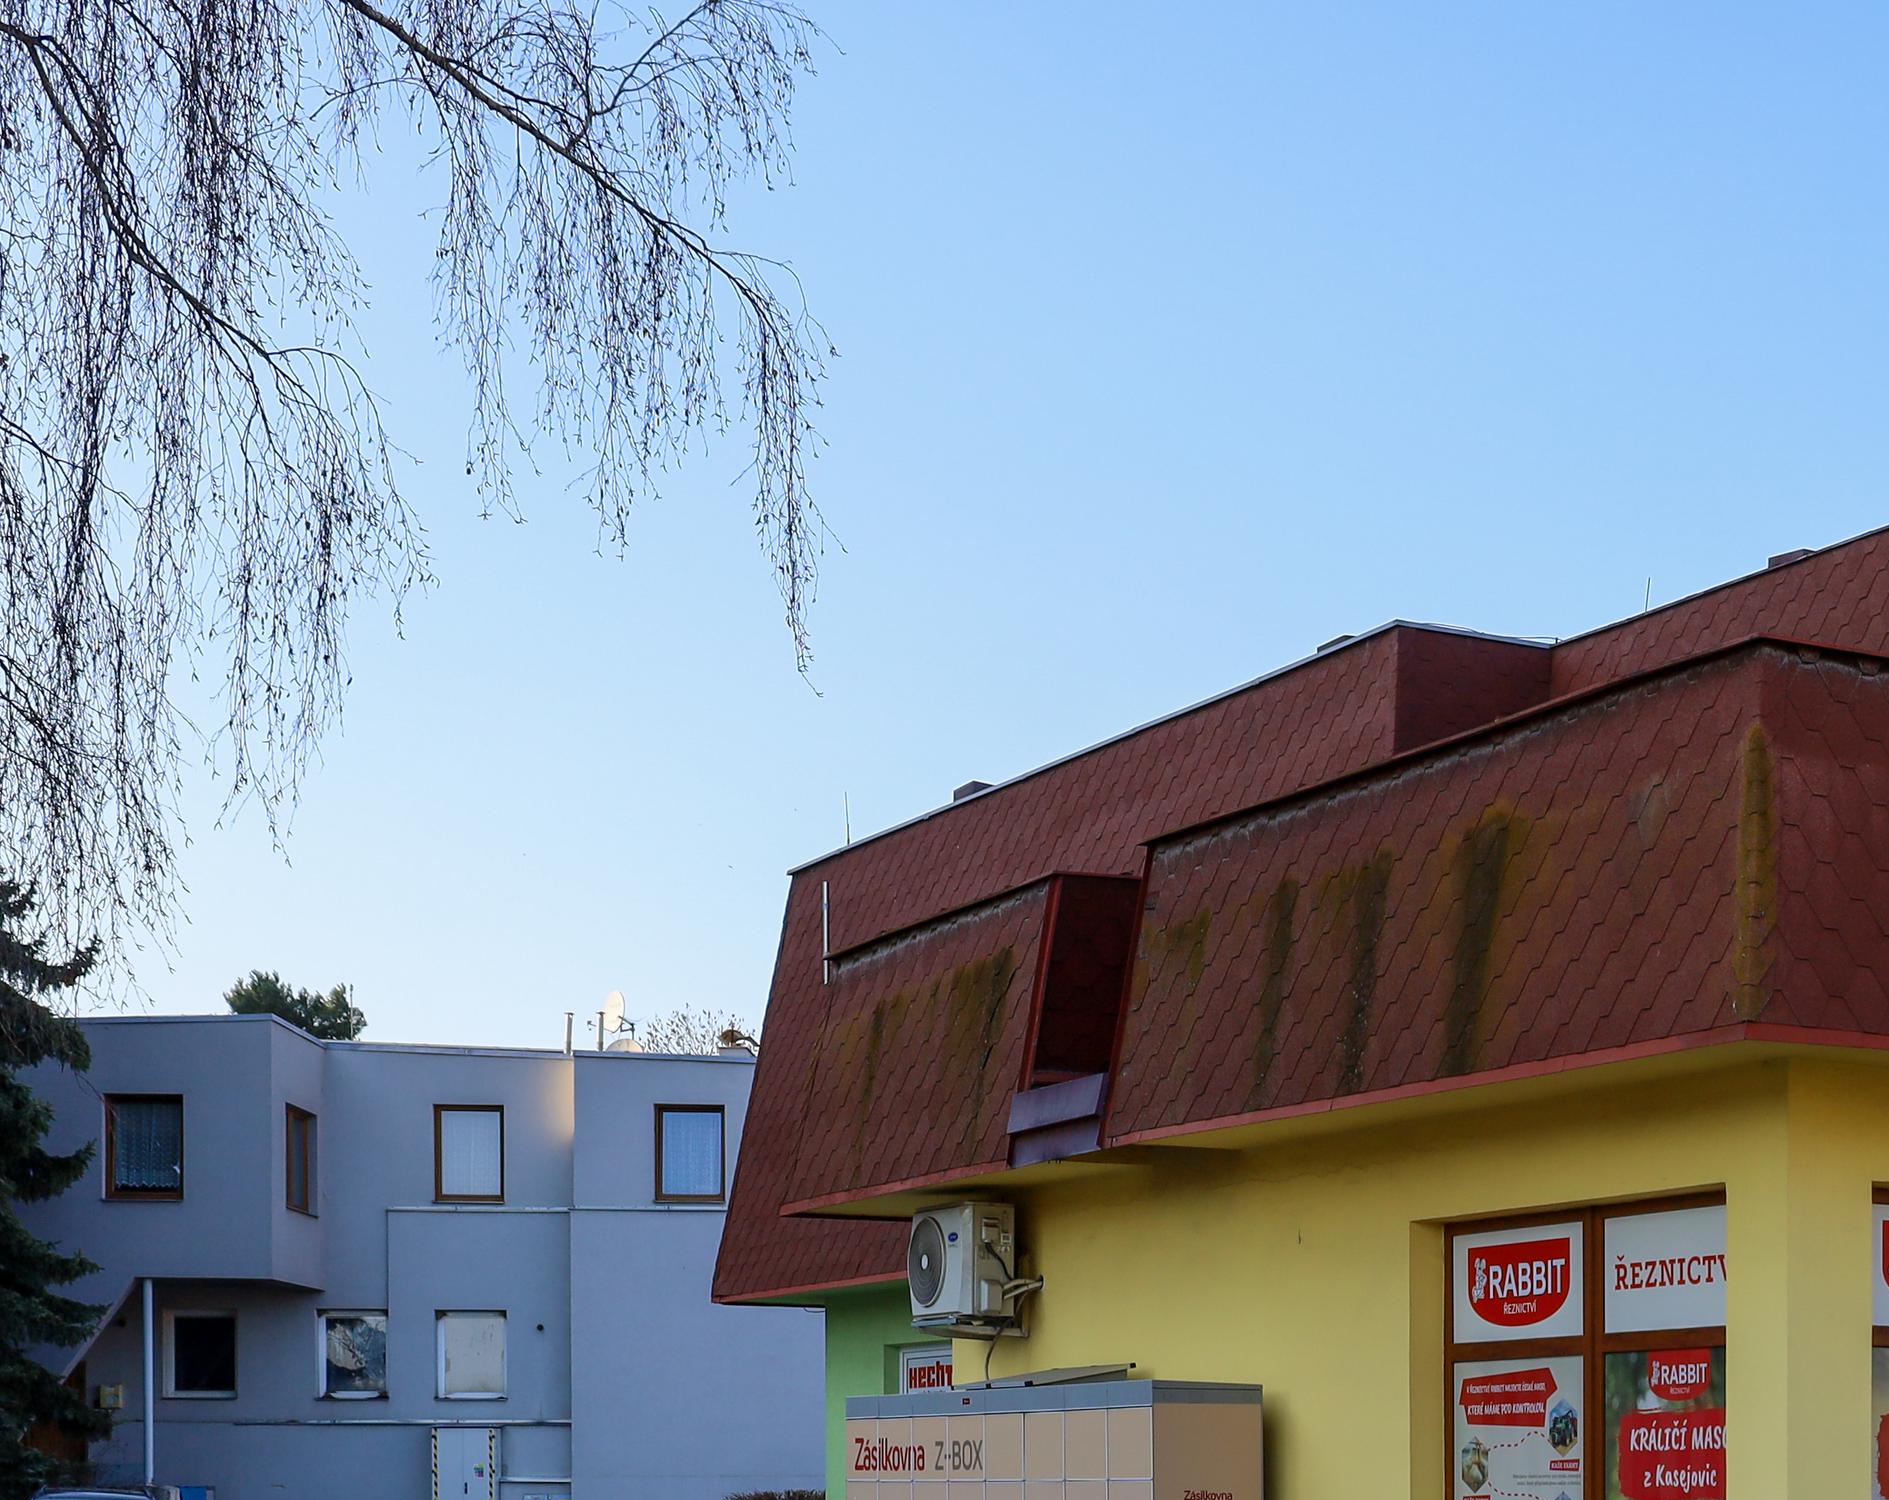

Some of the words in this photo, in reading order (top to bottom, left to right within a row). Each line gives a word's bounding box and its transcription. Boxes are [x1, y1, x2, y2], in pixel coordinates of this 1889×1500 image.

[1489, 1258, 1566, 1299] RABBIT
[1503, 1300, 1537, 1315] ŘEZNICTVÍ
[1661, 1363, 1708, 1385] RABBIT
[1630, 1419, 1688, 1452] KRÁLIČÍ
[854, 1437, 925, 1471] Zásilkovna
[1643, 1471, 1652, 1488] z
[1655, 1463, 1717, 1494] Kasejovic
[1183, 1489, 1233, 1500] Zásilkovna
